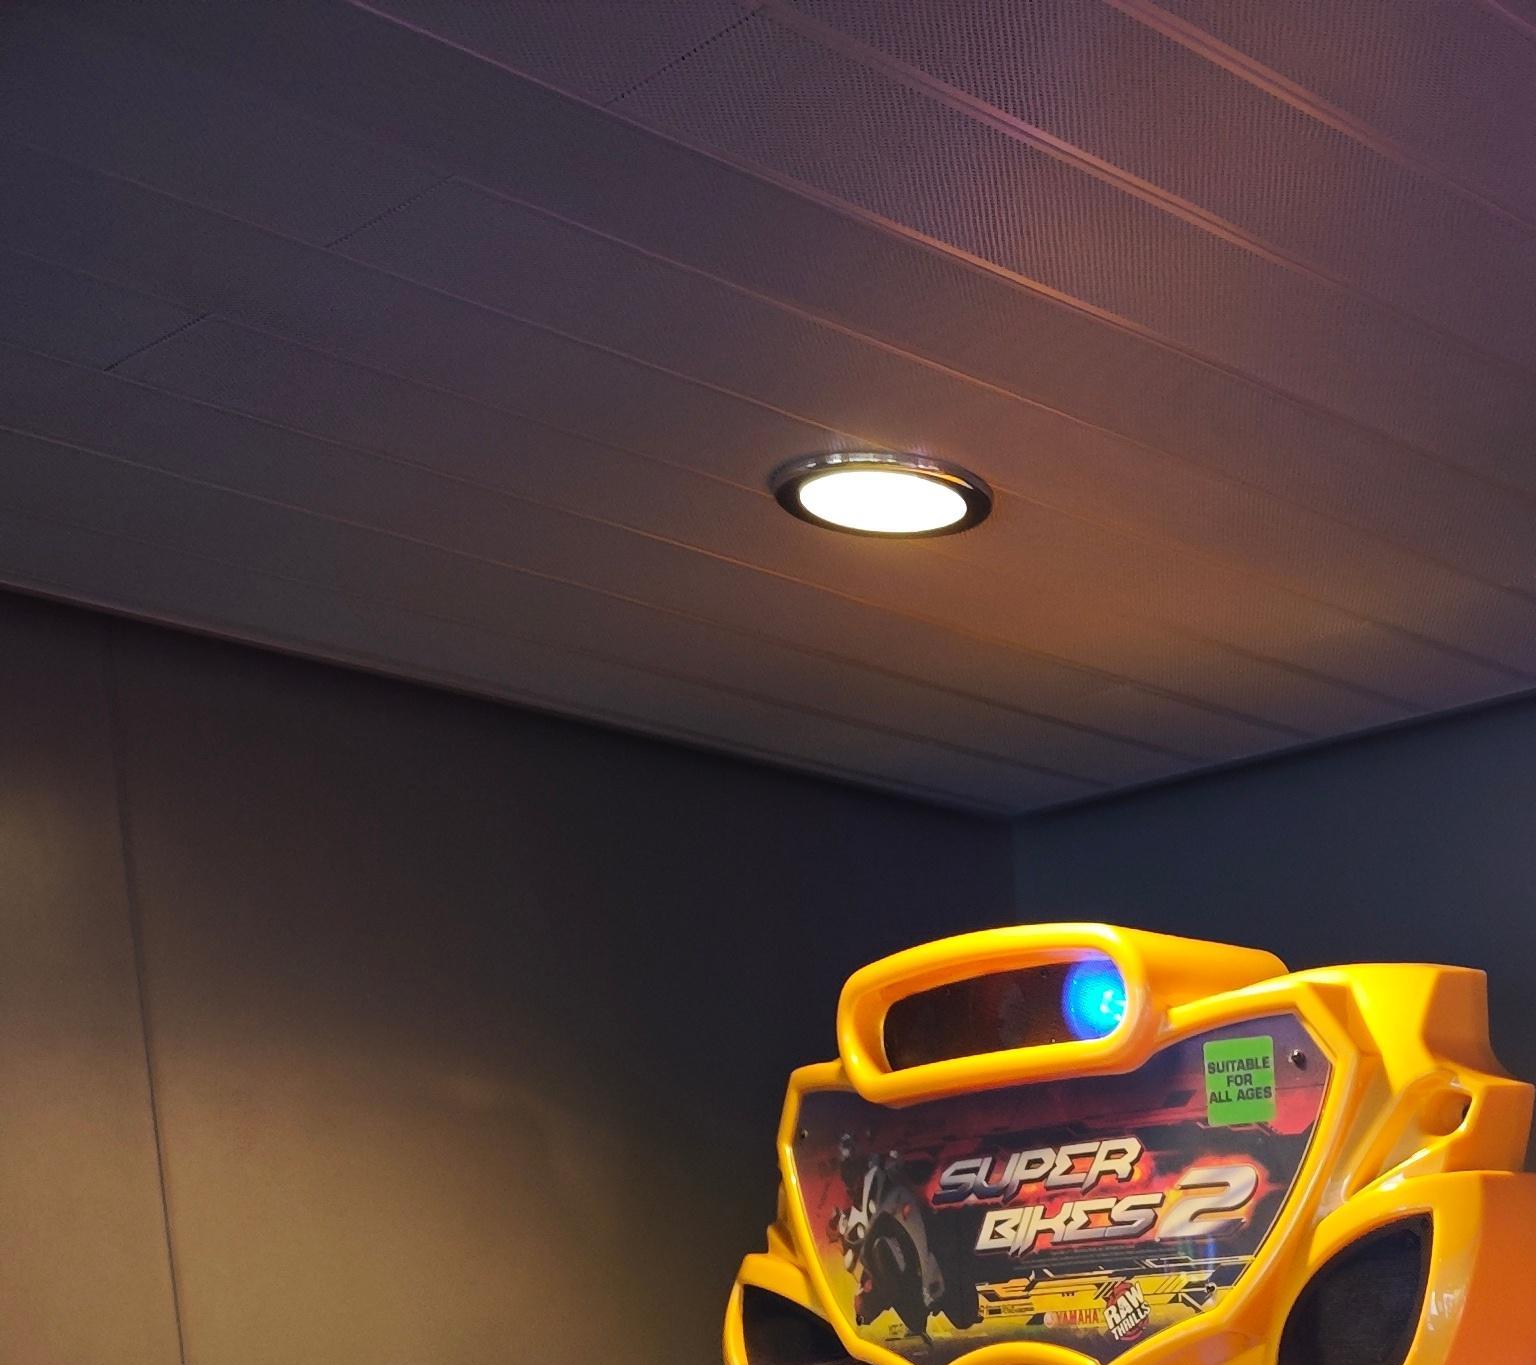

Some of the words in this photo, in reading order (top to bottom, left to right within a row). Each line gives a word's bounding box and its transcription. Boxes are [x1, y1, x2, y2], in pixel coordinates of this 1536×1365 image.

[1207, 1056, 1270, 1075] SUITABLE
[1226, 1073, 1253, 1087] FOR
[1210, 1090, 1232, 1104] ALL
[1237, 1086, 1272, 1101] AGES
[932, 1136, 1144, 1204] SUPER
[975, 1192, 1165, 1258] BIKES
[1155, 1163, 1260, 1242] 2
[1056, 1309, 1099, 1325] YAMAHA
[1104, 1281, 1145, 1329] RAW
[1111, 1302, 1151, 1341] THRILLS
